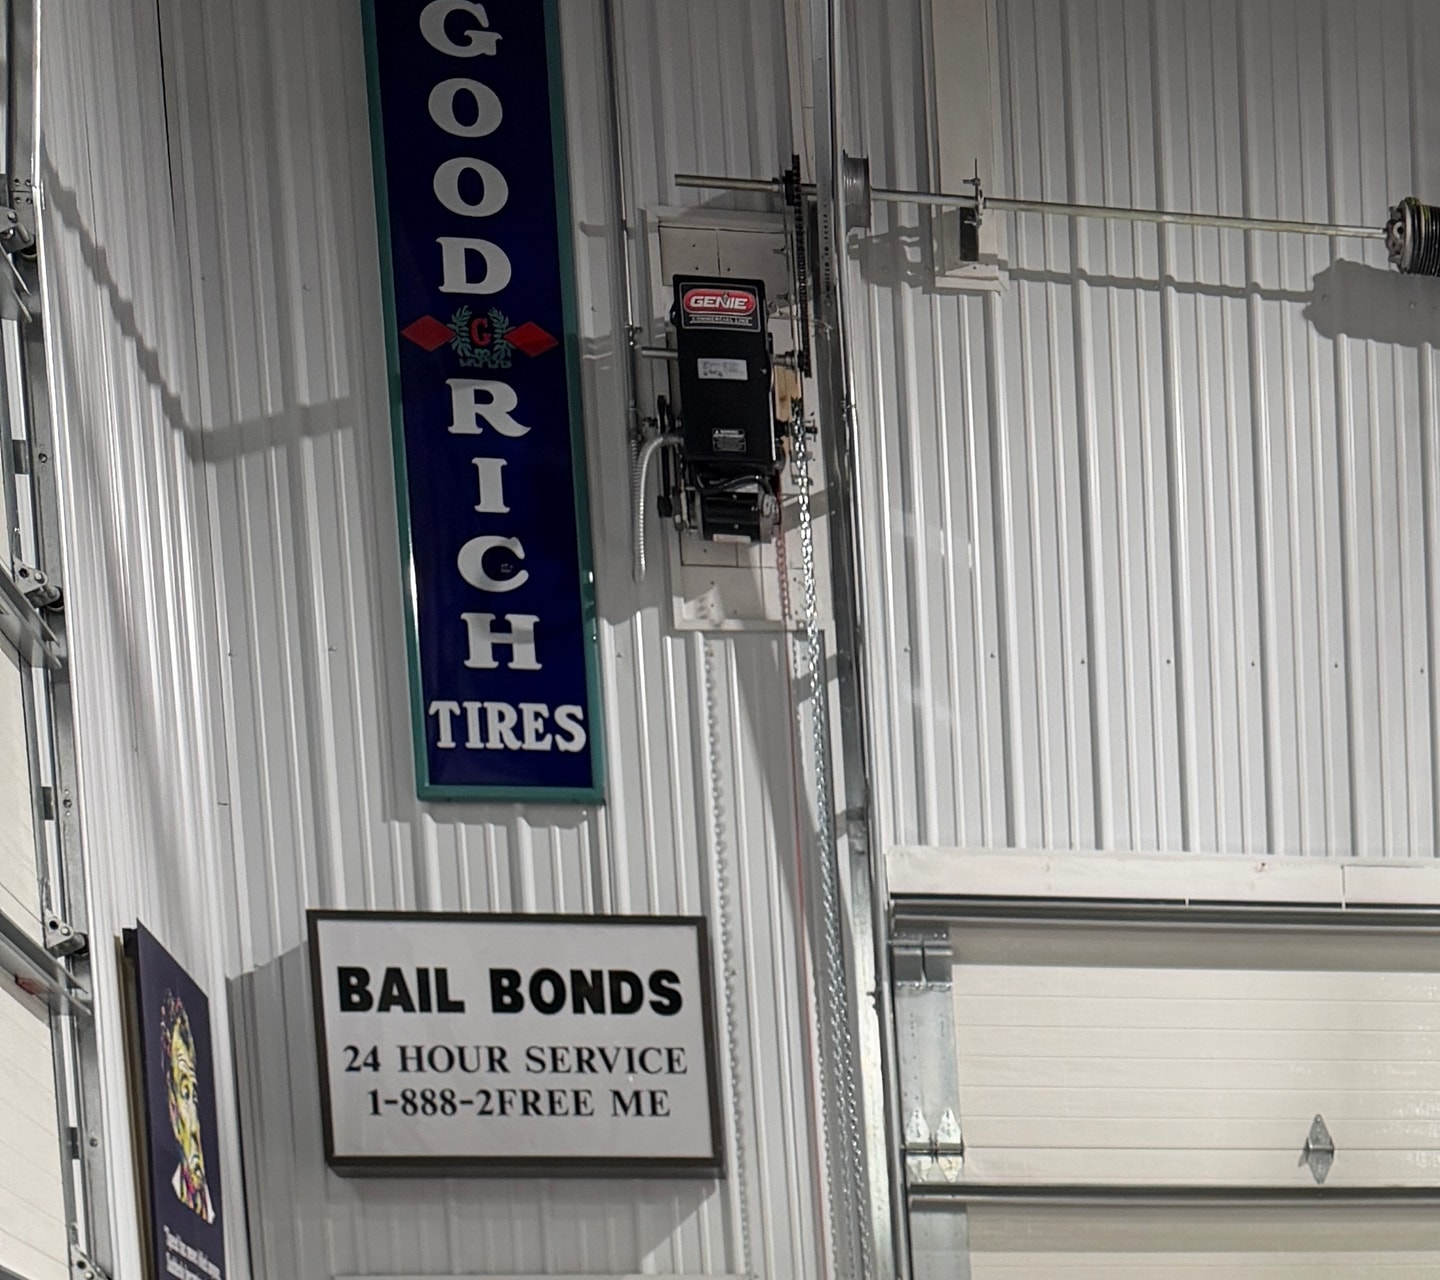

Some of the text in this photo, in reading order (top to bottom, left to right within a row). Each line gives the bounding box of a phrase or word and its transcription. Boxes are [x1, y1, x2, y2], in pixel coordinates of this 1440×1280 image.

[691, 296, 748, 309] GENIE
[470, 318, 492, 346] G
[429, 700, 587, 754] TIRES
[336, 965, 683, 1017] BAIL BONDS
[343, 1044, 688, 1075] 24 HOUR SERVICE
[367, 1088, 671, 1117] 1-888-2FREE ME
